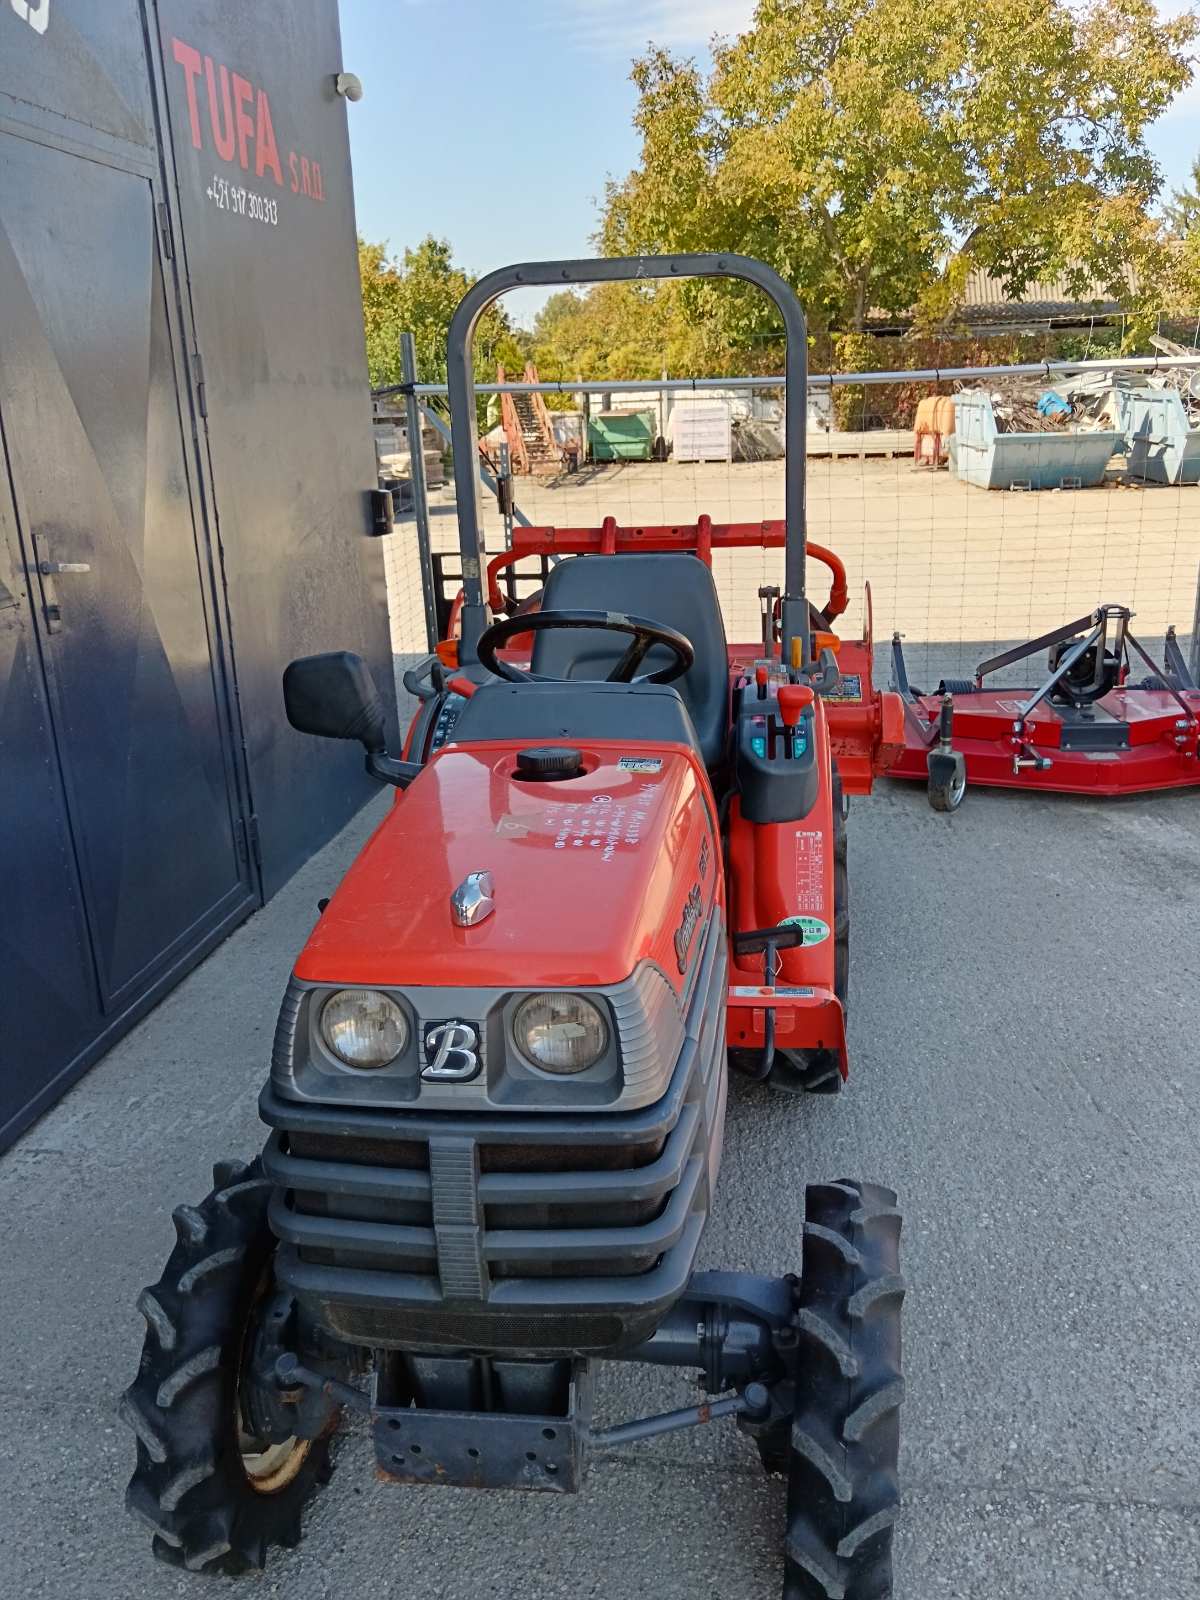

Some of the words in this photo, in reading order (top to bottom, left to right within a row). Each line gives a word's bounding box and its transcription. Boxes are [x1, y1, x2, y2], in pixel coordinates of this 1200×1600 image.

[172, 37, 283, 186] TUFA
[206, 174, 230, 211] +421
[231, 187, 247, 215] 917
[421, 1020, 478, 1078] B
